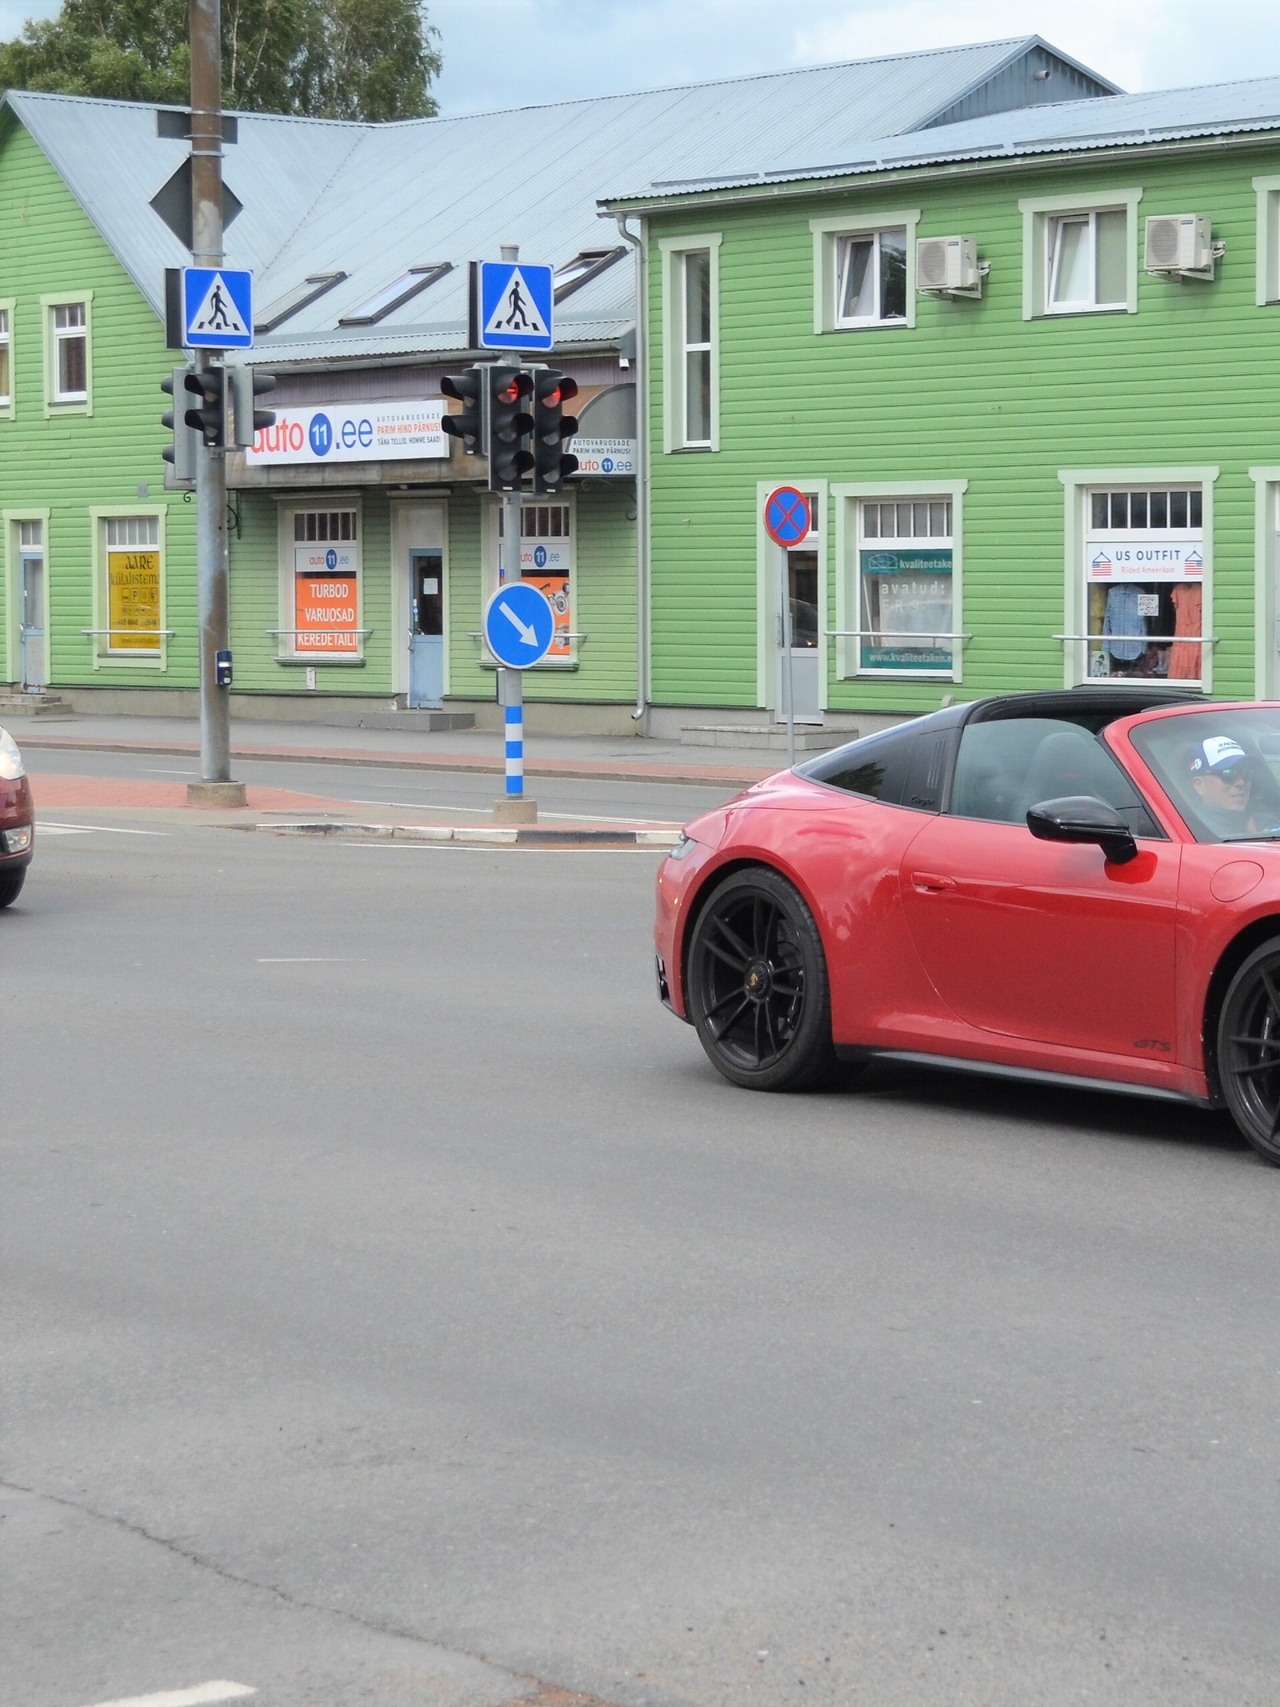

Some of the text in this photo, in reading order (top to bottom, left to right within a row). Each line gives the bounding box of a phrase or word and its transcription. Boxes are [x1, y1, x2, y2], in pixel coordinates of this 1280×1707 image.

[377, 424, 396, 434] PARIM
[397, 424, 412, 434] HIND
[377, 437, 390, 446] TÄNA
[1116, 550, 1181, 561] US OUTFIT
[1141, 566, 1175, 574] Ameerikast
[310, 584, 349, 598] TURBOD
[881, 581, 945, 595] avatud:
[305, 608, 355, 622] VARUOSAD
